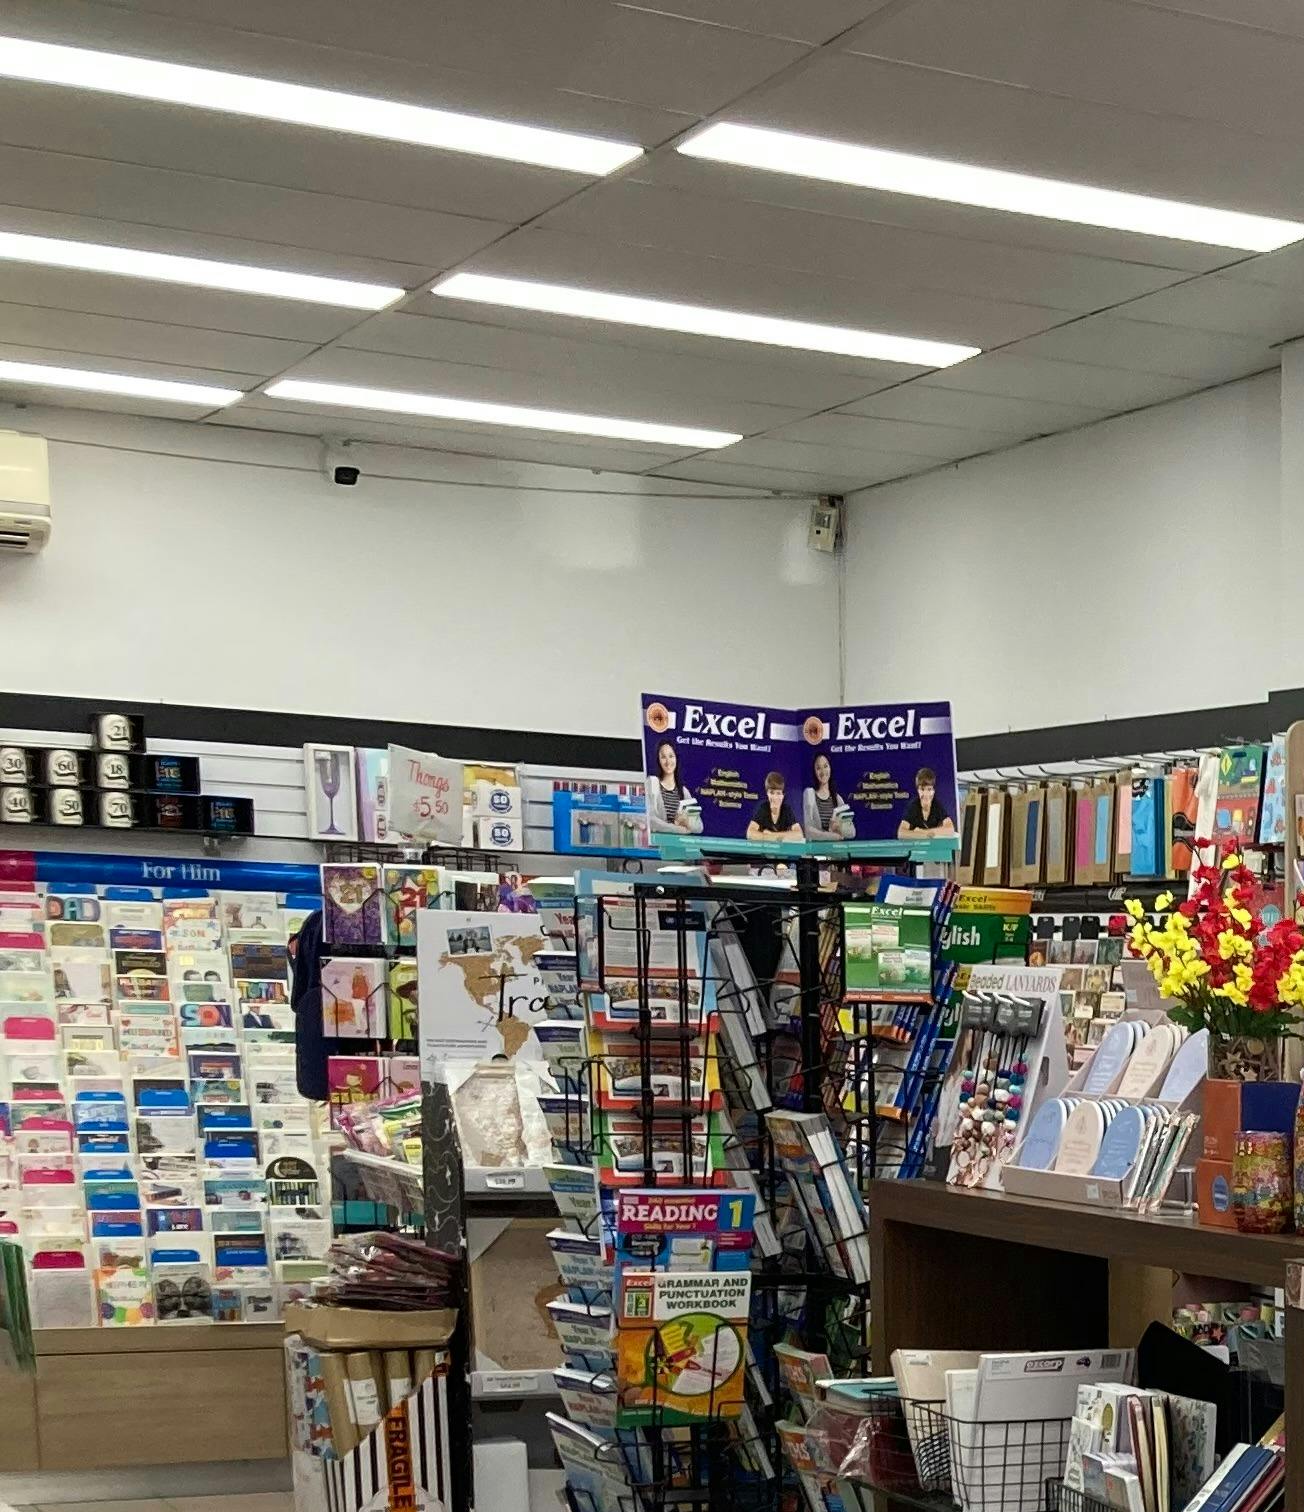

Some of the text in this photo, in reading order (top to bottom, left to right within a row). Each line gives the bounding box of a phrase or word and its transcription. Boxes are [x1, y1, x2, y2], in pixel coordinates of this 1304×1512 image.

[683, 705, 766, 740] Excel
[837, 710, 915, 741] Excel
[6, 759, 22, 769] 30
[142, 862, 221, 880] For Him
[959, 895, 987, 903] Excel
[872, 906, 902, 917] Excel
[1006, 975, 1057, 993] LANYARDS
[623, 1205, 718, 1221] READING
[729, 1200, 743, 1228] 1
[658, 1278, 748, 1289] GRAMMAR AND
[660, 1289, 745, 1299] PUNCTUATION
[667, 1300, 736, 1310] WORKBOOK
[387, 1414, 416, 1510] FRAGILE
